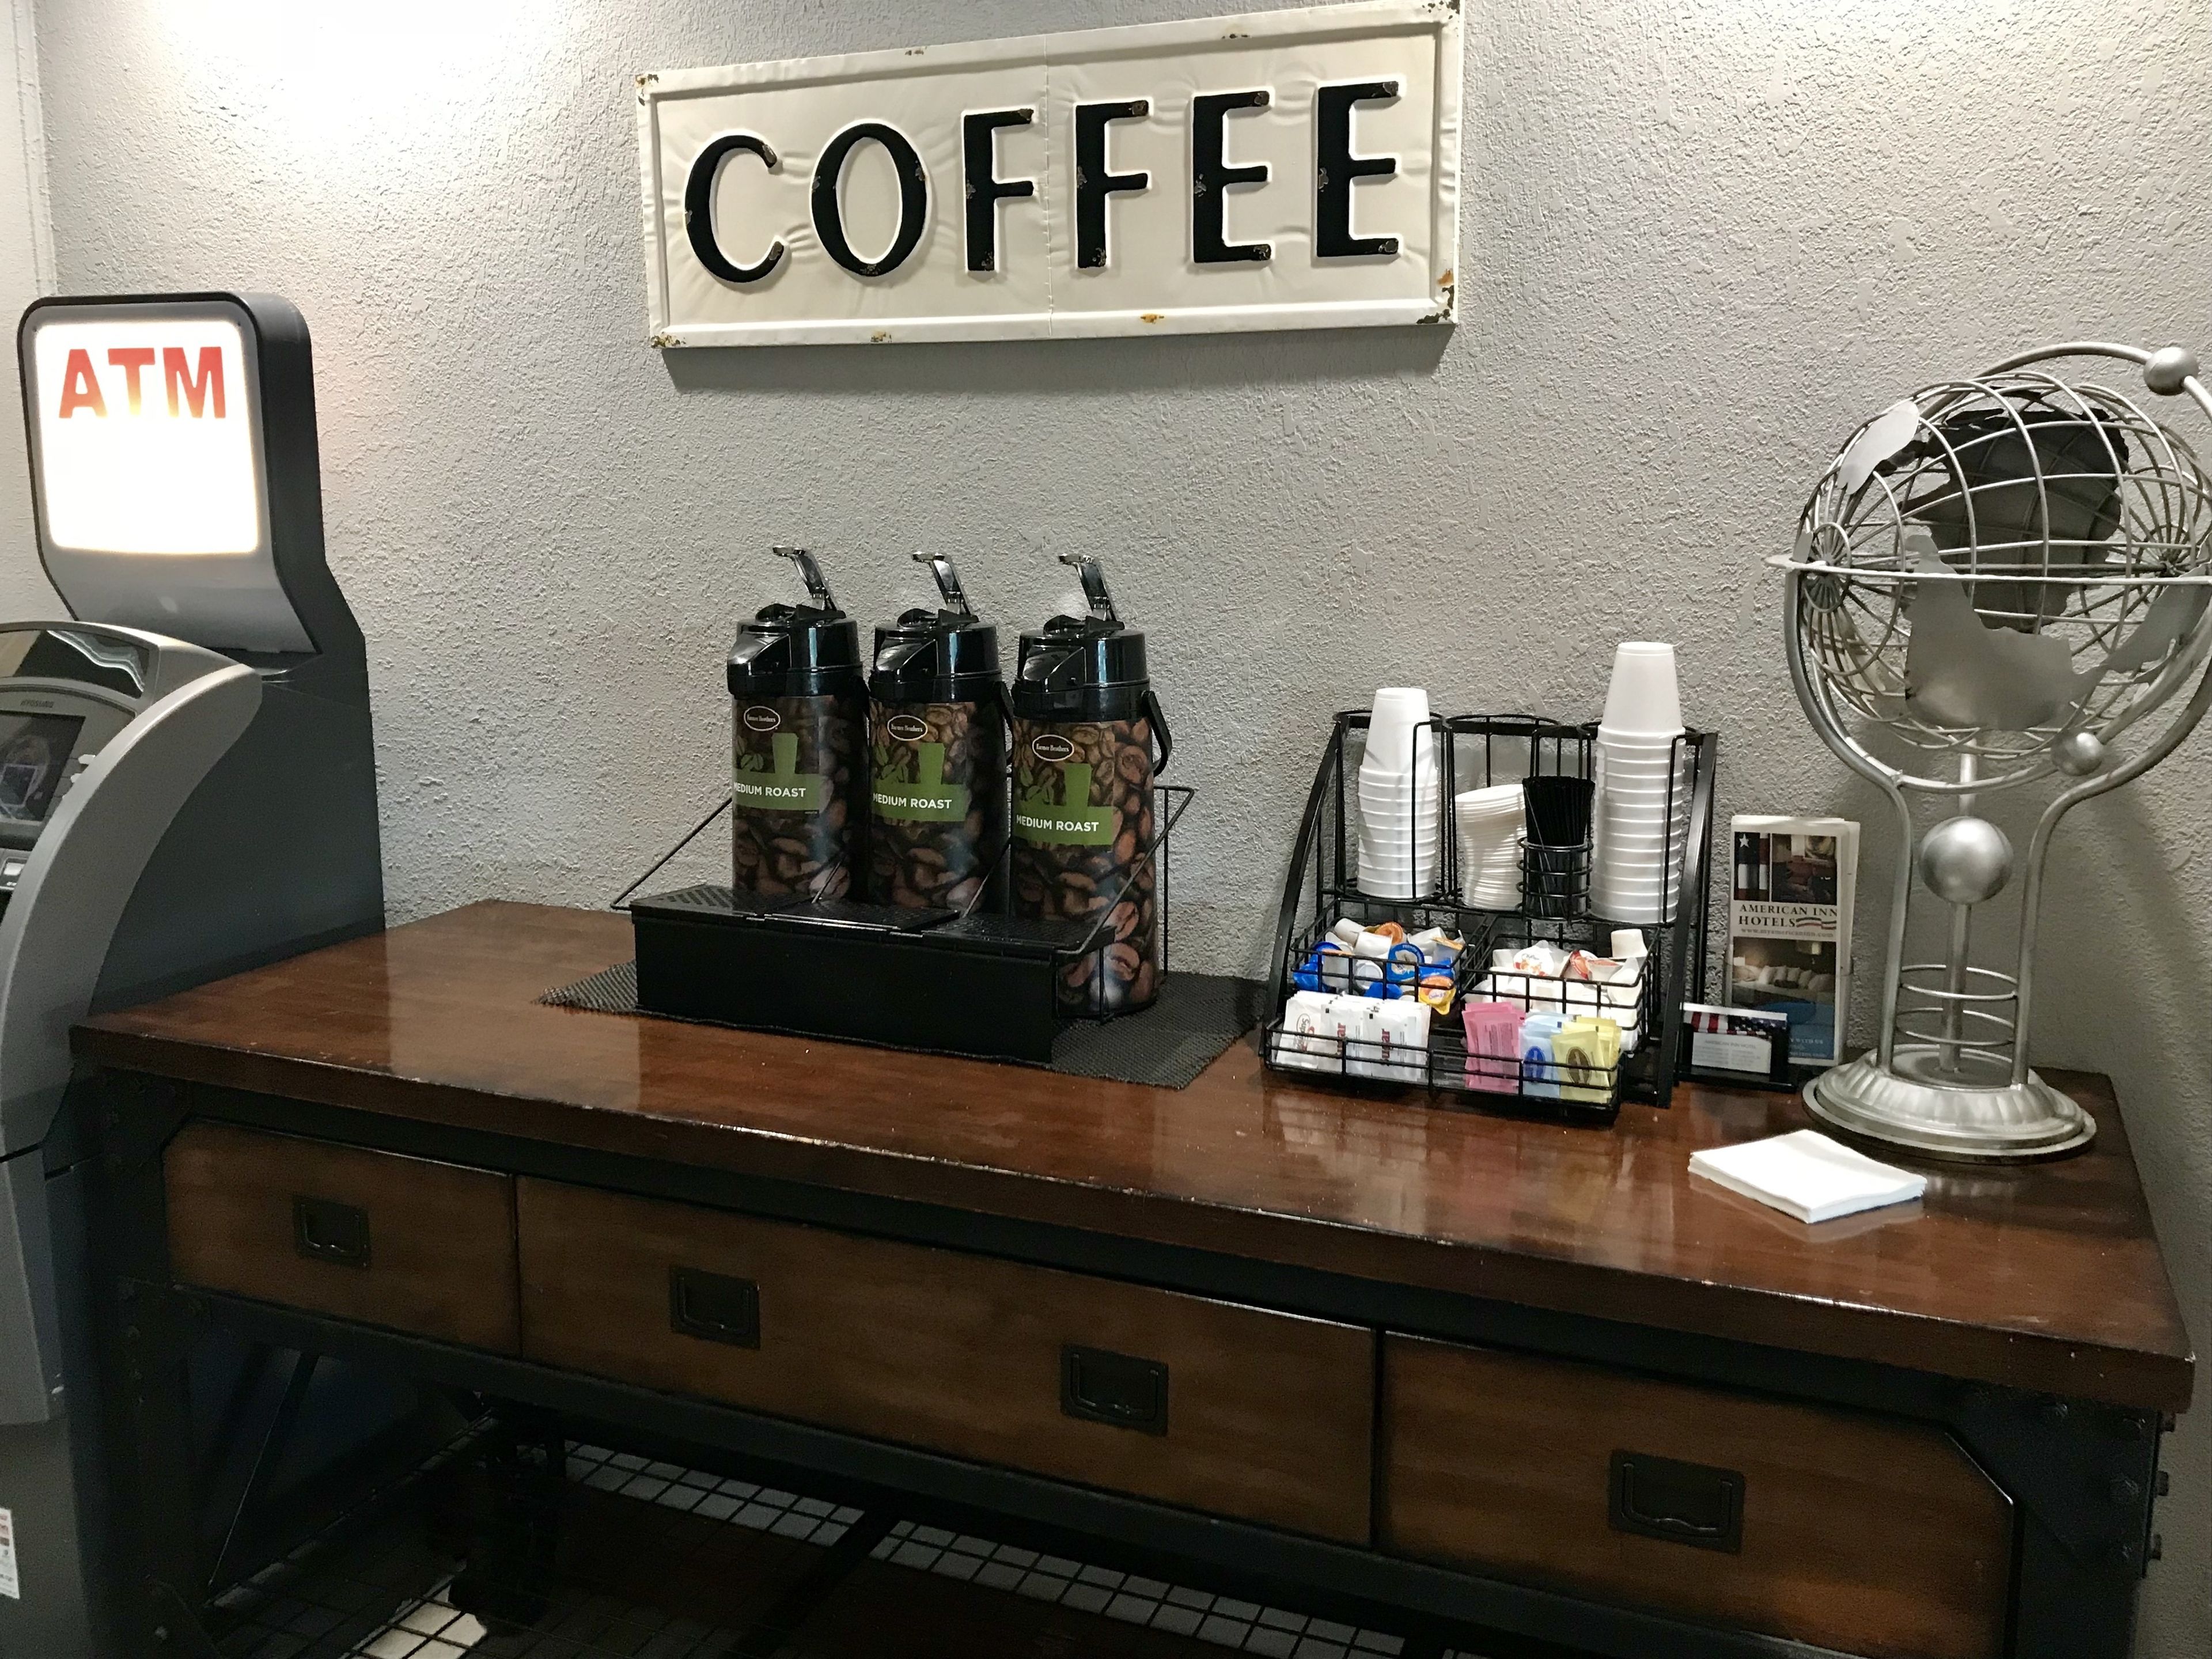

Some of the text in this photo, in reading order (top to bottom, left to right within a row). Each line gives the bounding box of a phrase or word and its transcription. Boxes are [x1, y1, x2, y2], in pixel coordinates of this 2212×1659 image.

[684, 81, 1400, 282] COFFEE
[59, 346, 226, 419] ATM
[733, 782, 806, 798] MEDIUM ROAST
[873, 793, 952, 809] MEDIUM ROAST
[1016, 815, 1099, 832] MEDIUM ROAST
[1740, 904, 1838, 916] AMERICAN INN
[1738, 916, 1796, 927] HOTELS
